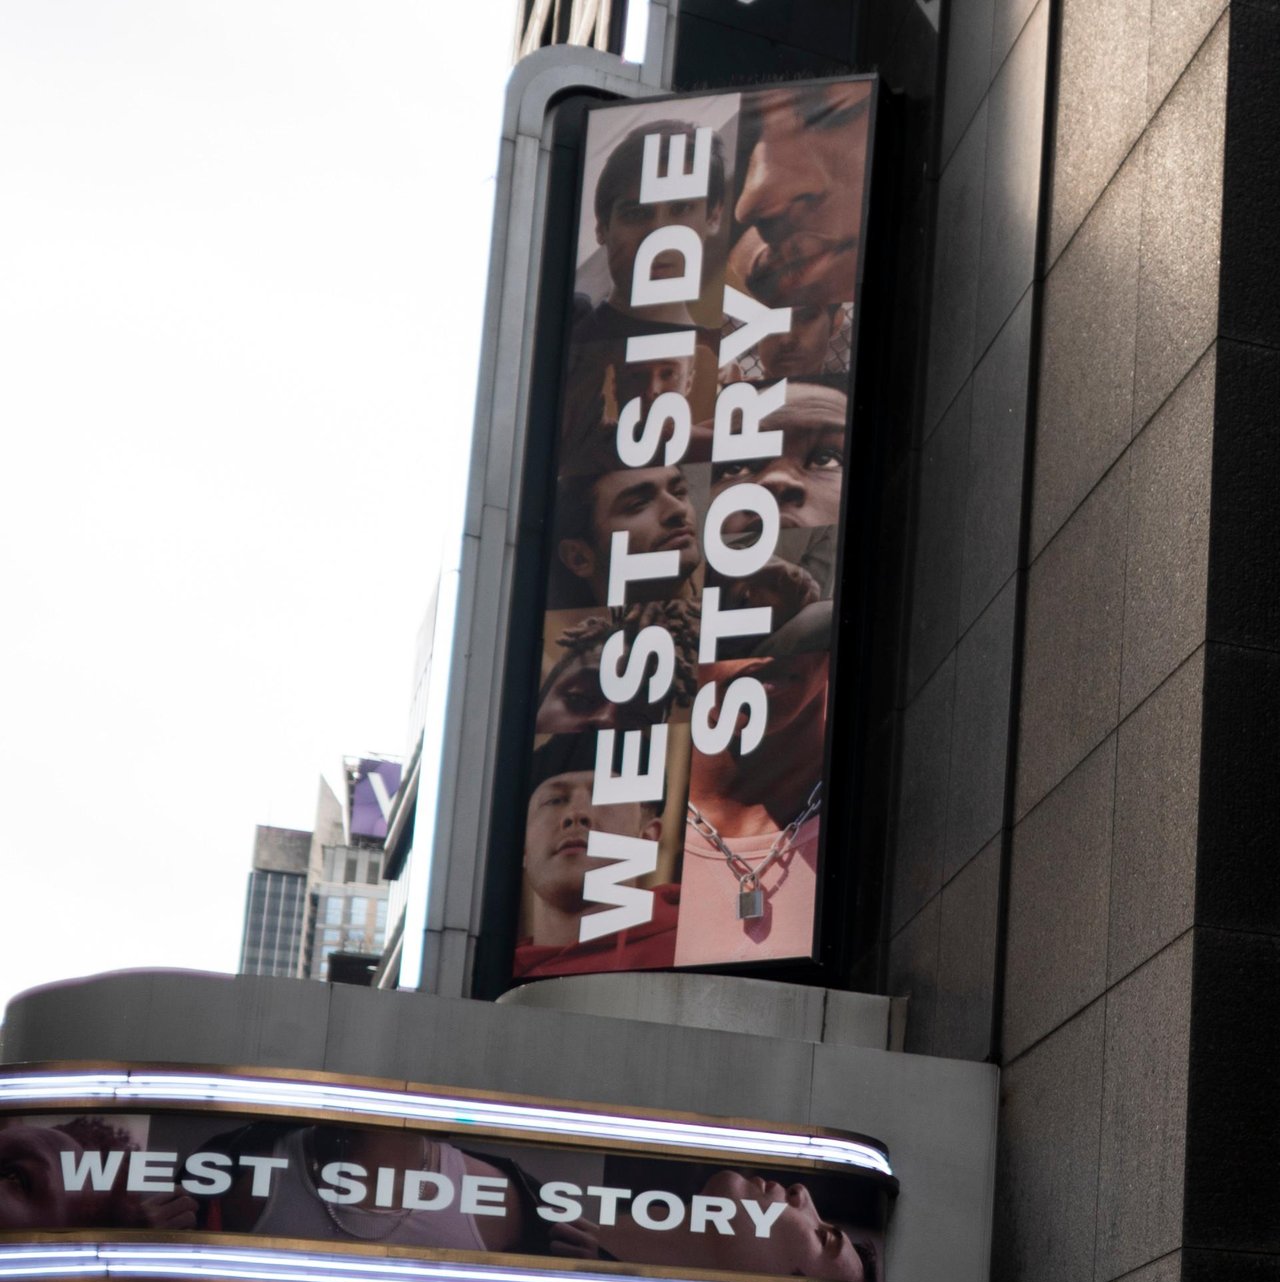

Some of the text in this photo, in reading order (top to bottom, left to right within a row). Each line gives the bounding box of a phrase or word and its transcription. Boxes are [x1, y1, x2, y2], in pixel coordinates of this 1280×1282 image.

[579, 126, 712, 943] WEST SIDE
[691, 285, 791, 757] STORY
[61, 1150, 789, 1238] WEST SIDE STORY
